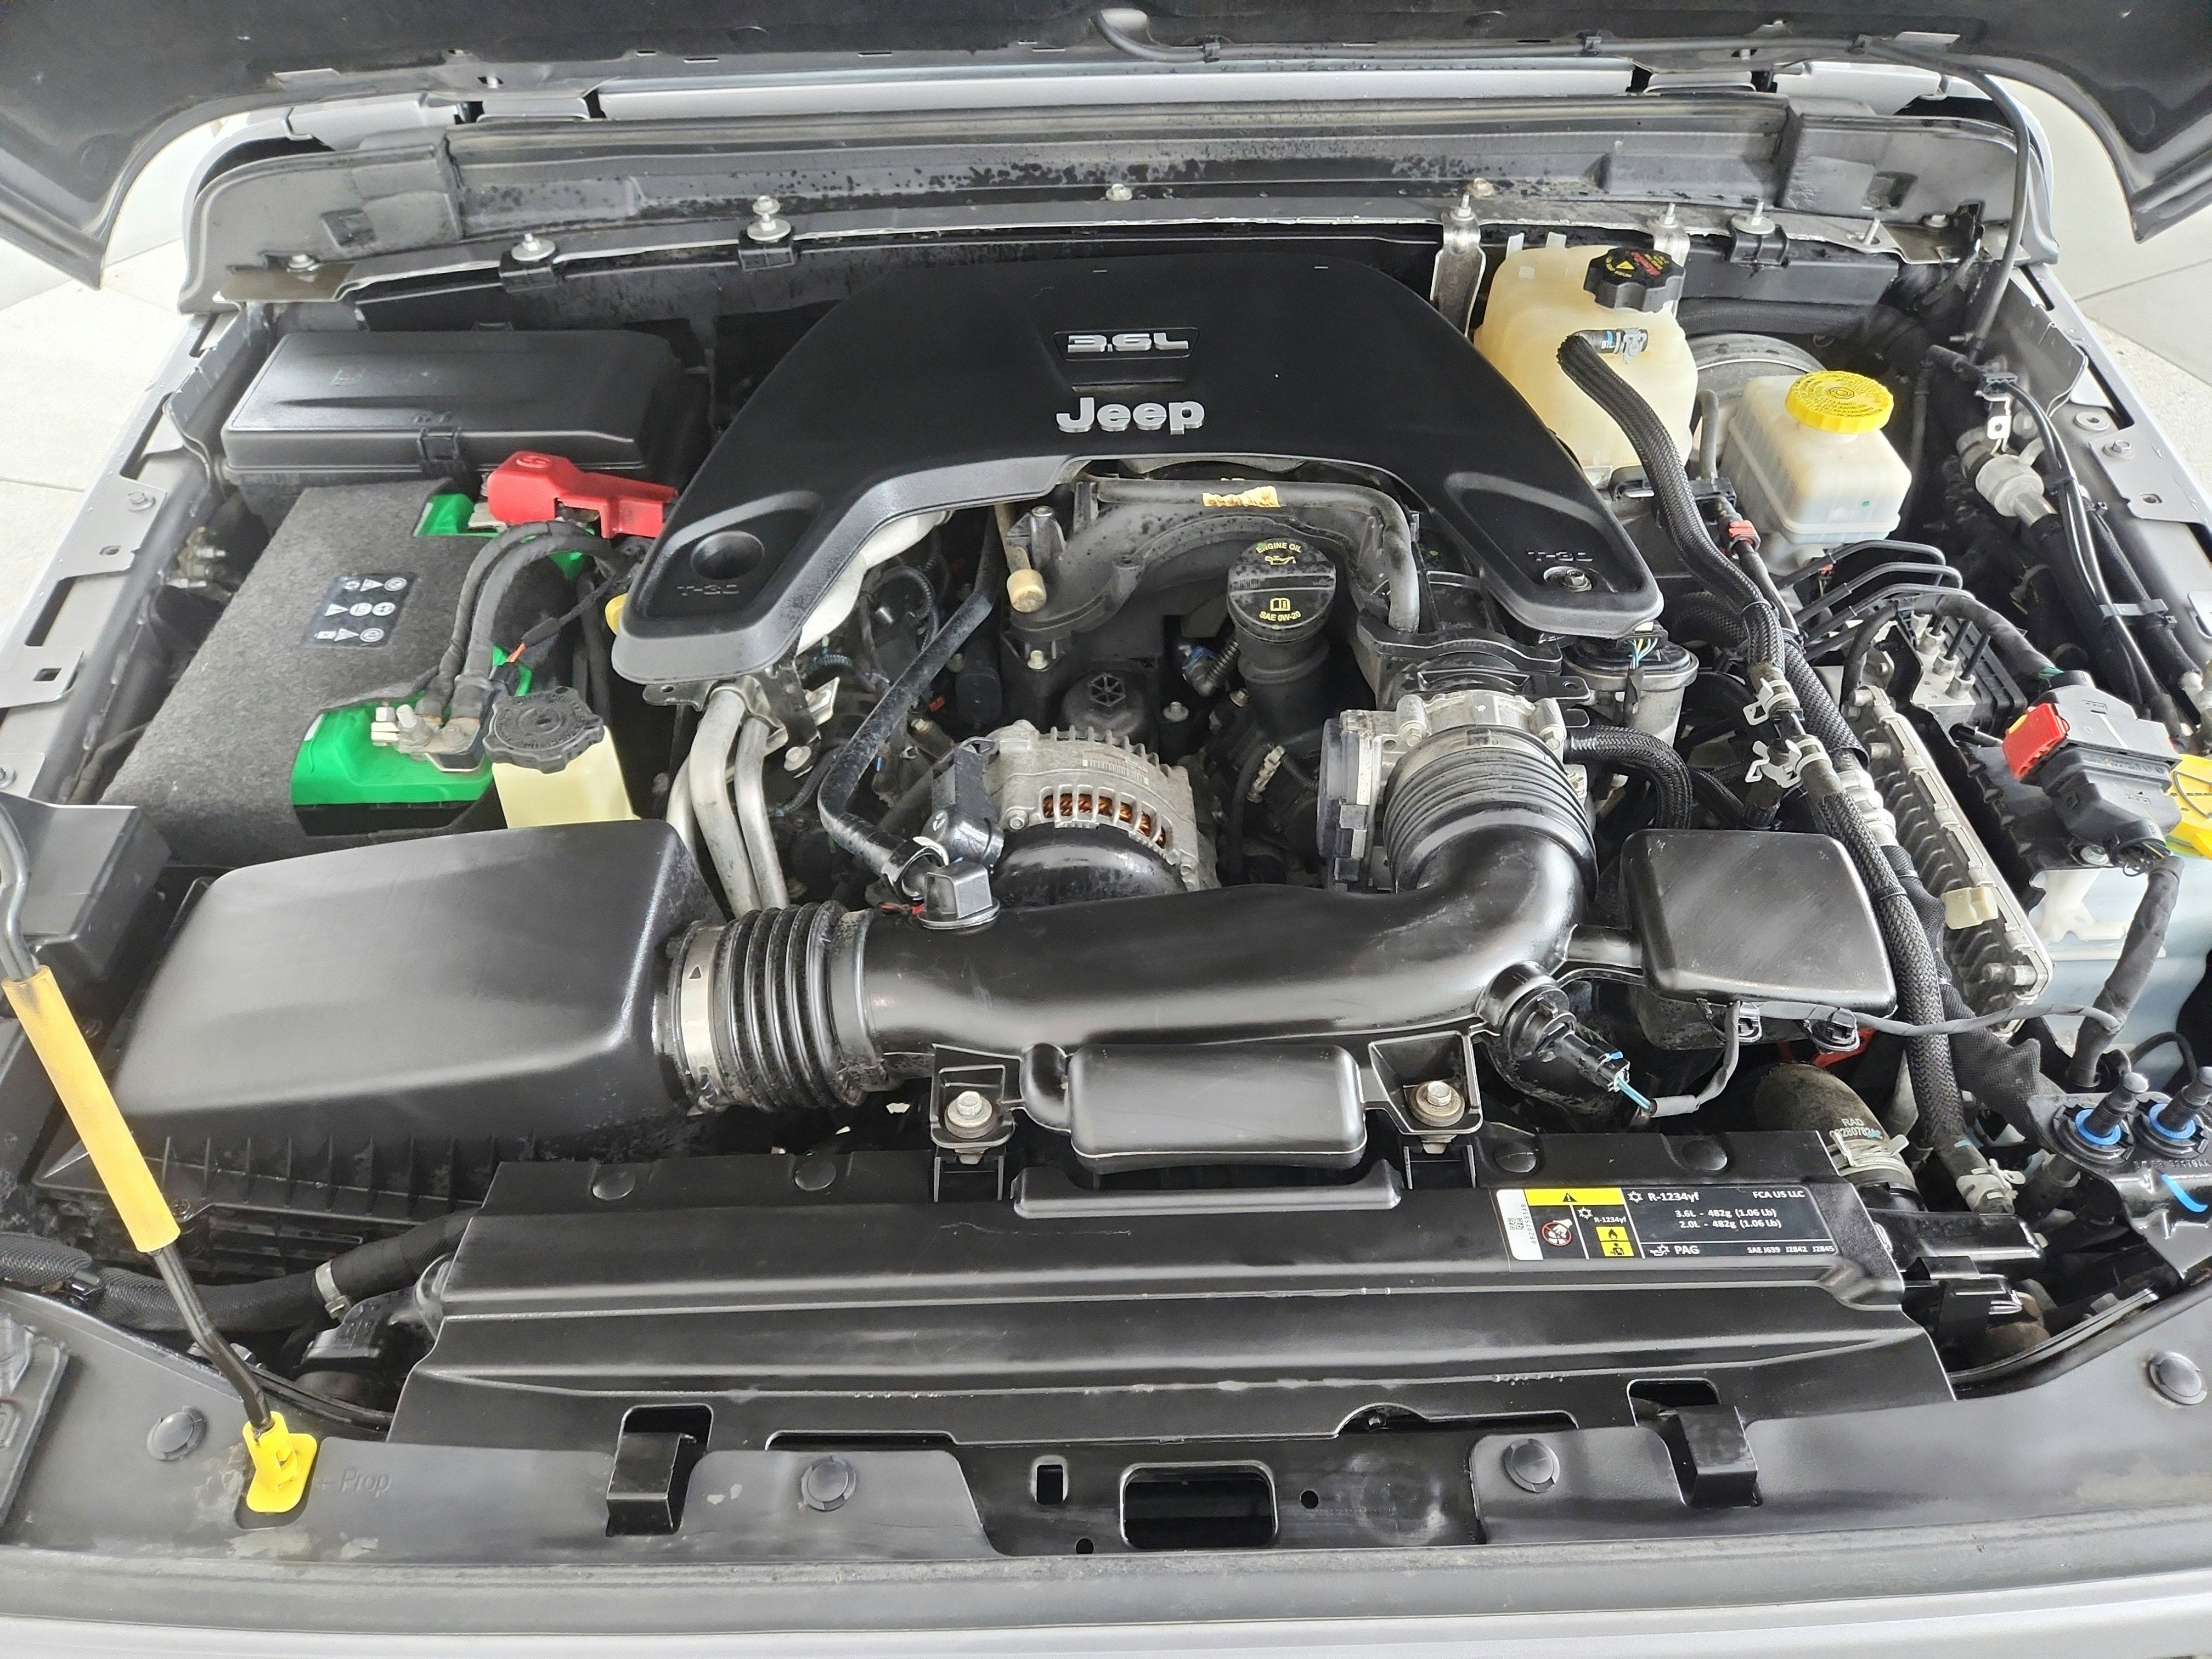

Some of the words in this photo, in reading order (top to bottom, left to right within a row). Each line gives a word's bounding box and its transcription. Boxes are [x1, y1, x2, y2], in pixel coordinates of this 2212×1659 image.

[1068, 332, 1189, 353] 3.6L
[1056, 397, 1205, 435] Jeep
[1256, 542, 1288, 553] ENGINE
[1289, 543, 1302, 553] OIL
[1259, 611, 1277, 621] SAE
[1277, 611, 1301, 622] 0W-20
[1841, 1118, 1865, 1126] RAD
[1647, 1192, 1700, 1203] R-1234yf
[1787, 1190, 1805, 1198] LLC
[1674, 1209, 1696, 1217] 3.6L
[1708, 1209, 1733, 1218] 482g
[1735, 1209, 1760, 1218] (1.06
[1760, 1208, 1777, 1217] Lb)
[1593, 1216, 1627, 1224] R-1234yf
[1712, 1220, 1737, 1229] 482g
[1739, 1220, 1765, 1229] (1.06
[1764, 1219, 1782, 1228] Lb)
[1674, 1245, 1701, 1255] PAG
[340, 1467, 392, 1498] Prop
